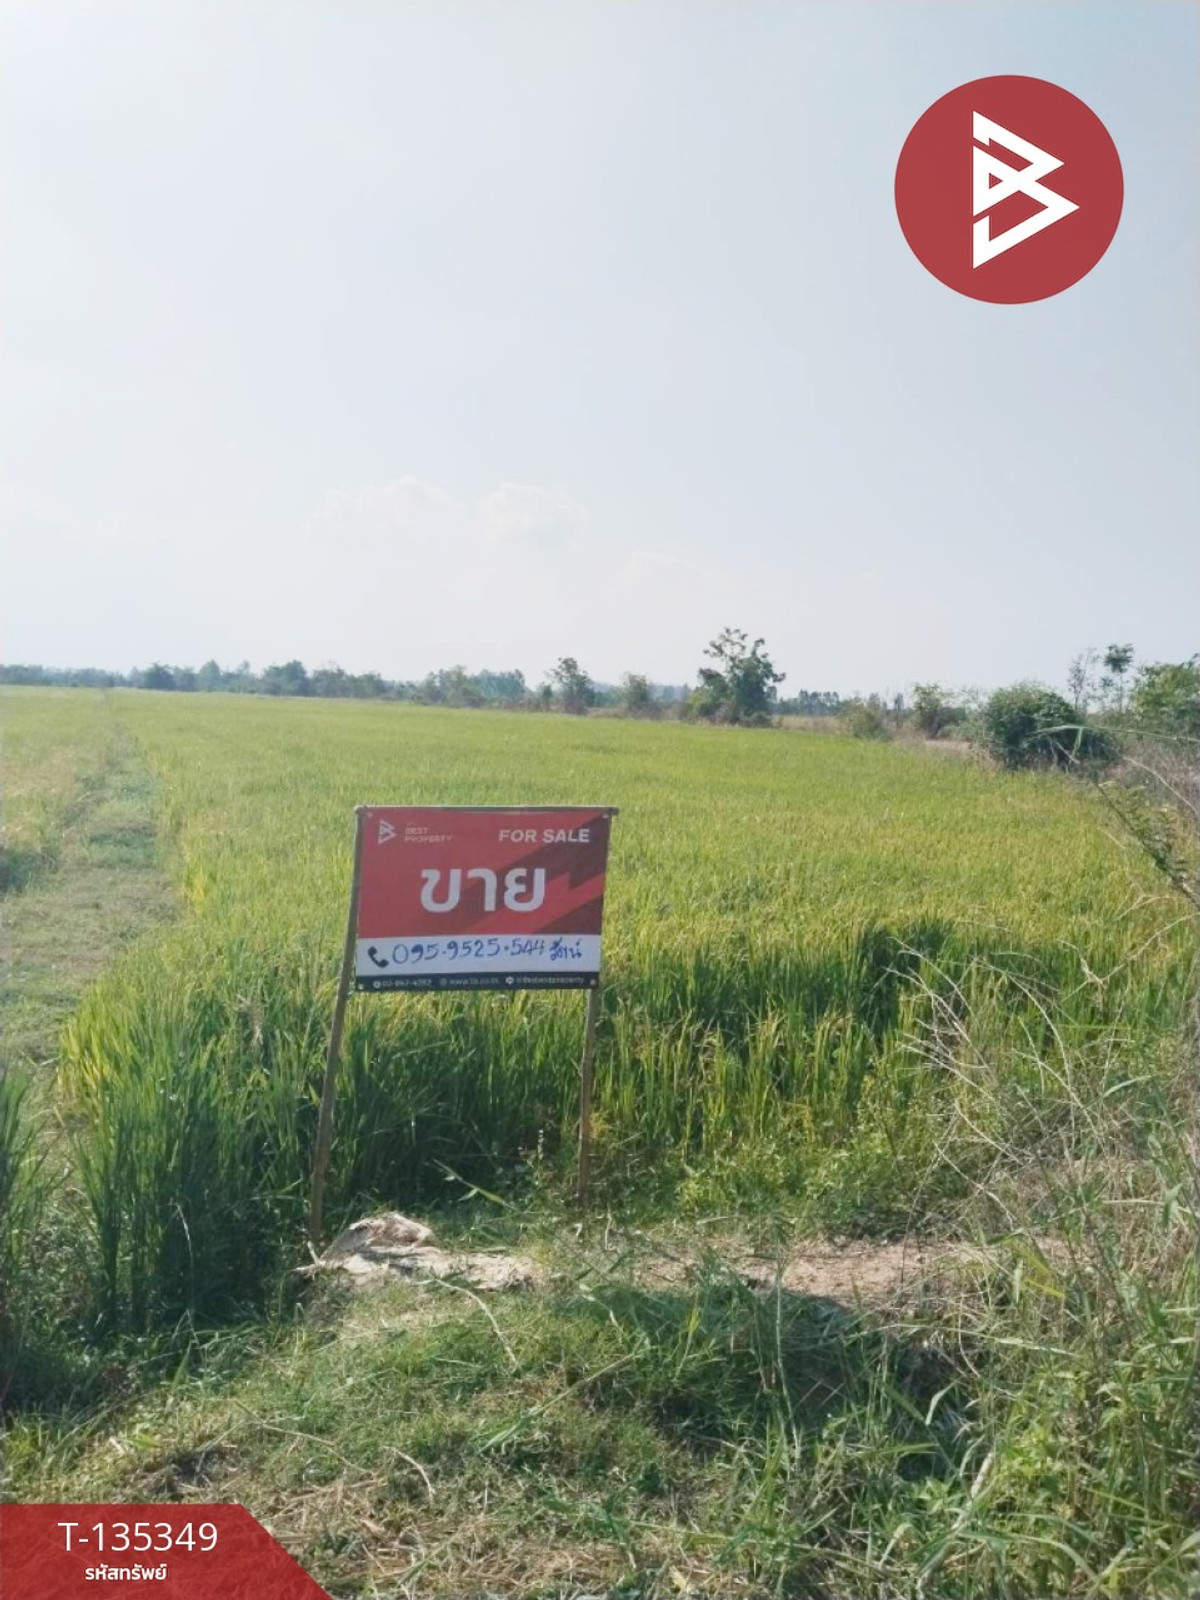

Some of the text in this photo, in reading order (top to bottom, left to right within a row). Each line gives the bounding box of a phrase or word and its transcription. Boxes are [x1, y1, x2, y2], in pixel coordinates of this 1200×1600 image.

[498, 828, 590, 843] FOR SALE
[420, 867, 546, 913] ขาย
